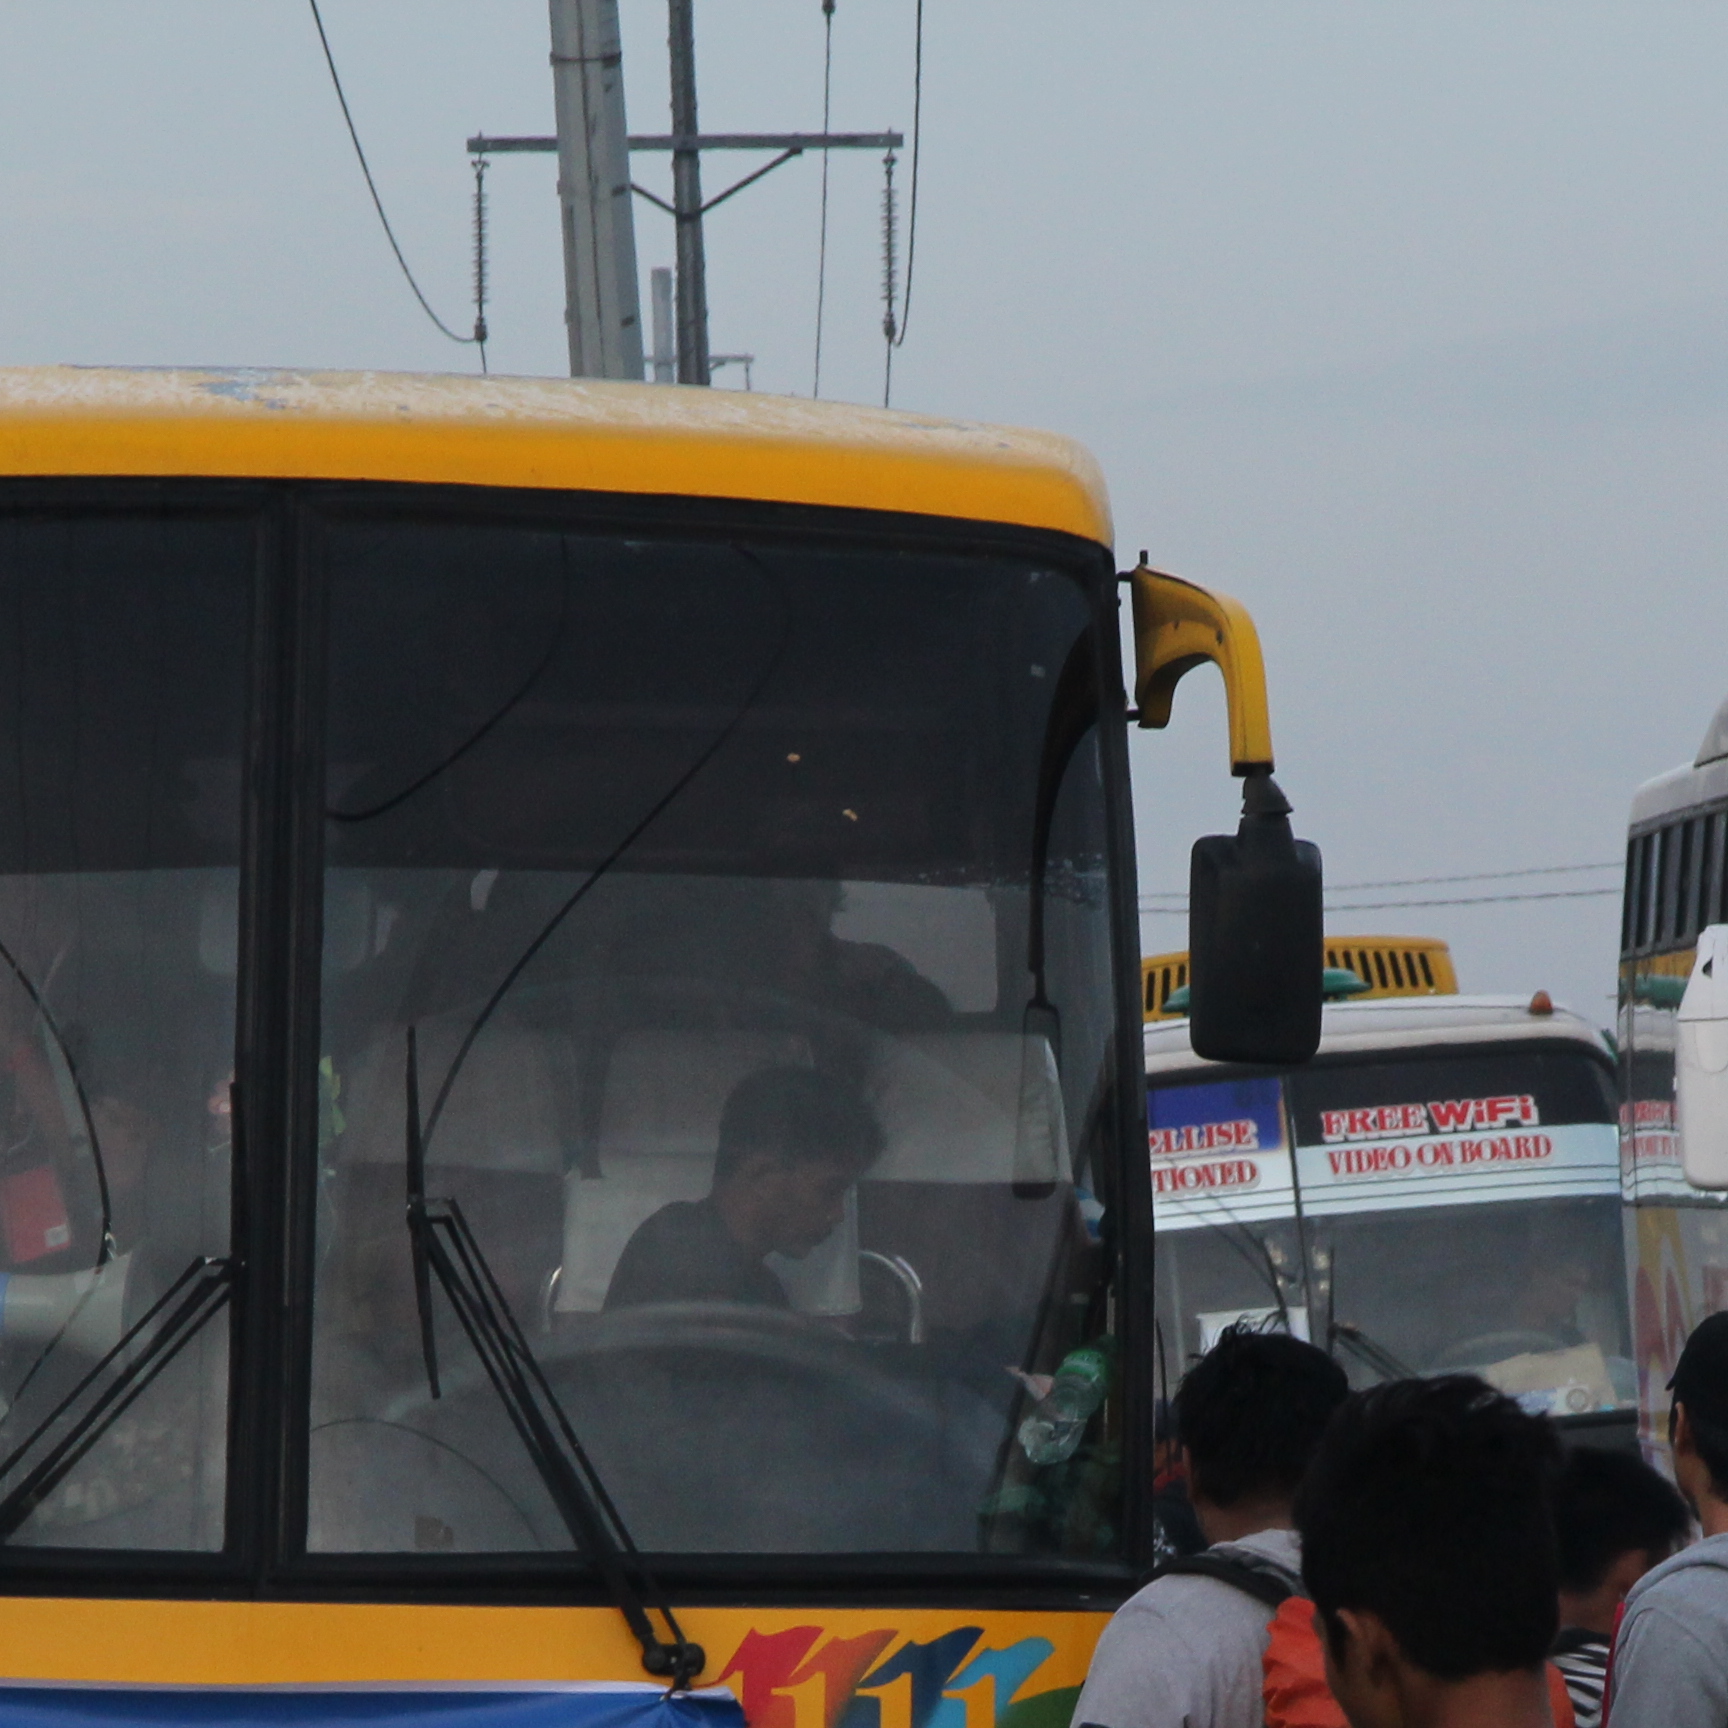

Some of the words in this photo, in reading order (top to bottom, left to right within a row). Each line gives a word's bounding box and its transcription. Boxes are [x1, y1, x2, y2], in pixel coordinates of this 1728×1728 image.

[1322, 1103, 1427, 1140] FREE
[1428, 1096, 1537, 1131] WiFi
[1327, 1145, 1412, 1176] VIDEO
[1416, 1142, 1454, 1167] ON
[1460, 1133, 1553, 1165] BOARD
